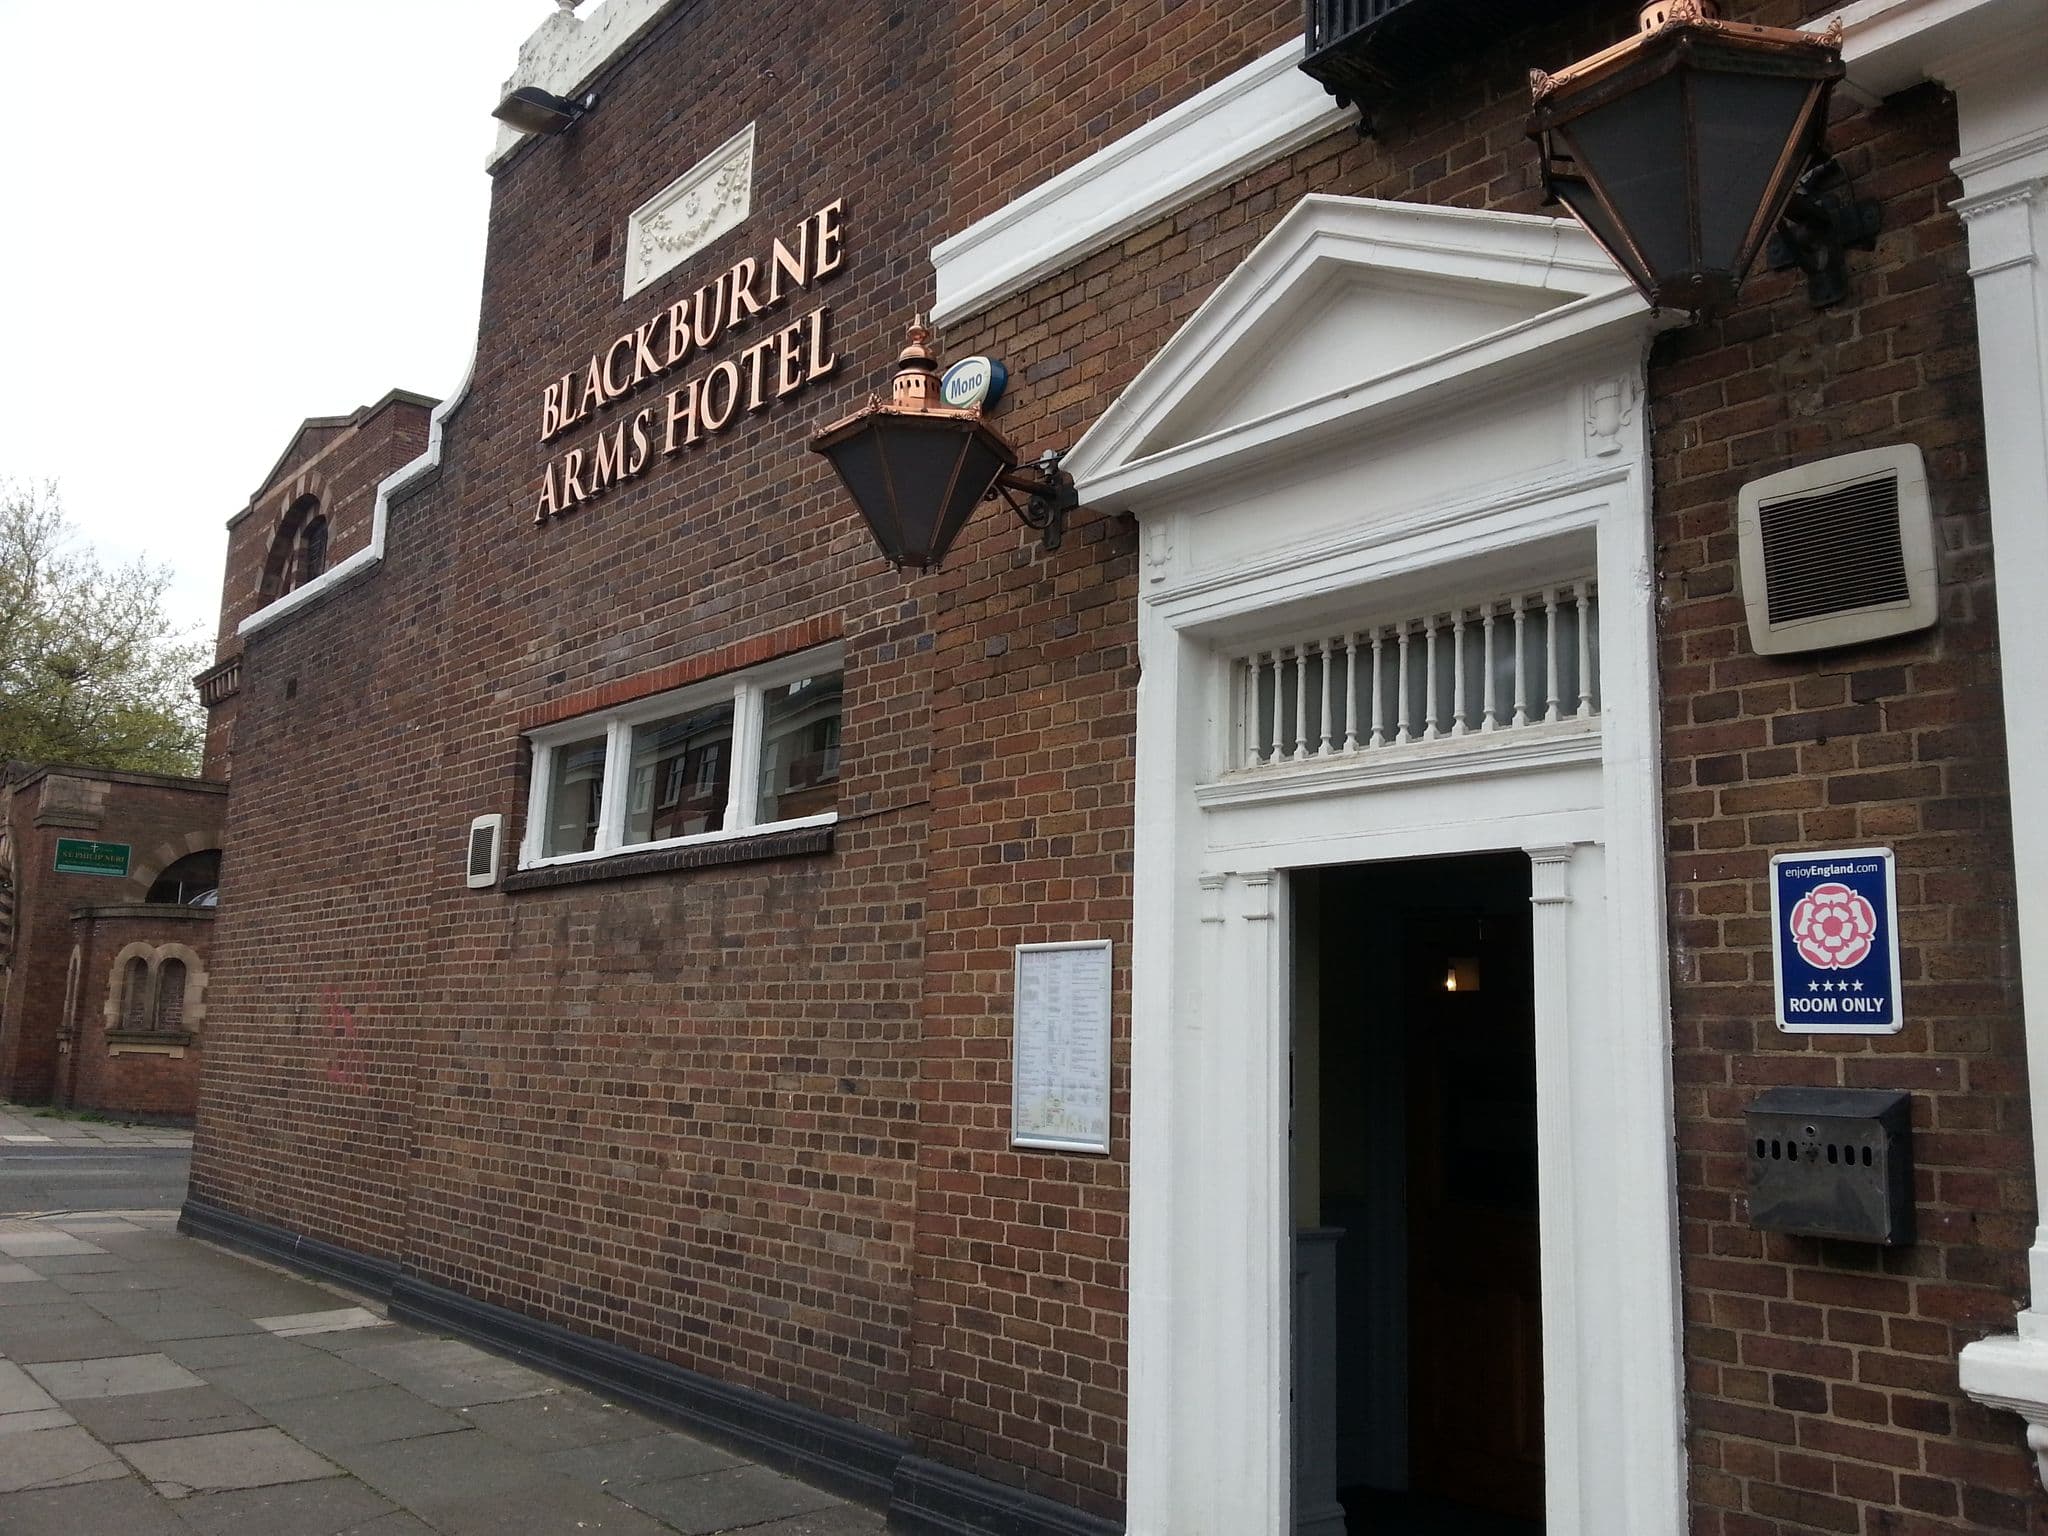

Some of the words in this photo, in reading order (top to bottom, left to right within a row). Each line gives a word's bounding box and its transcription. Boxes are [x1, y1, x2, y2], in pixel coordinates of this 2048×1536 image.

[540, 198, 843, 442] BLACKBURNE
[951, 373, 983, 400] Mono
[534, 408, 654, 524] ARMS
[664, 306, 836, 455] HOTEL
[1785, 863, 1878, 878] enjoyEngland.com
[1790, 998, 1838, 1012] ROOM
[1842, 998, 1885, 1012] ONLY
